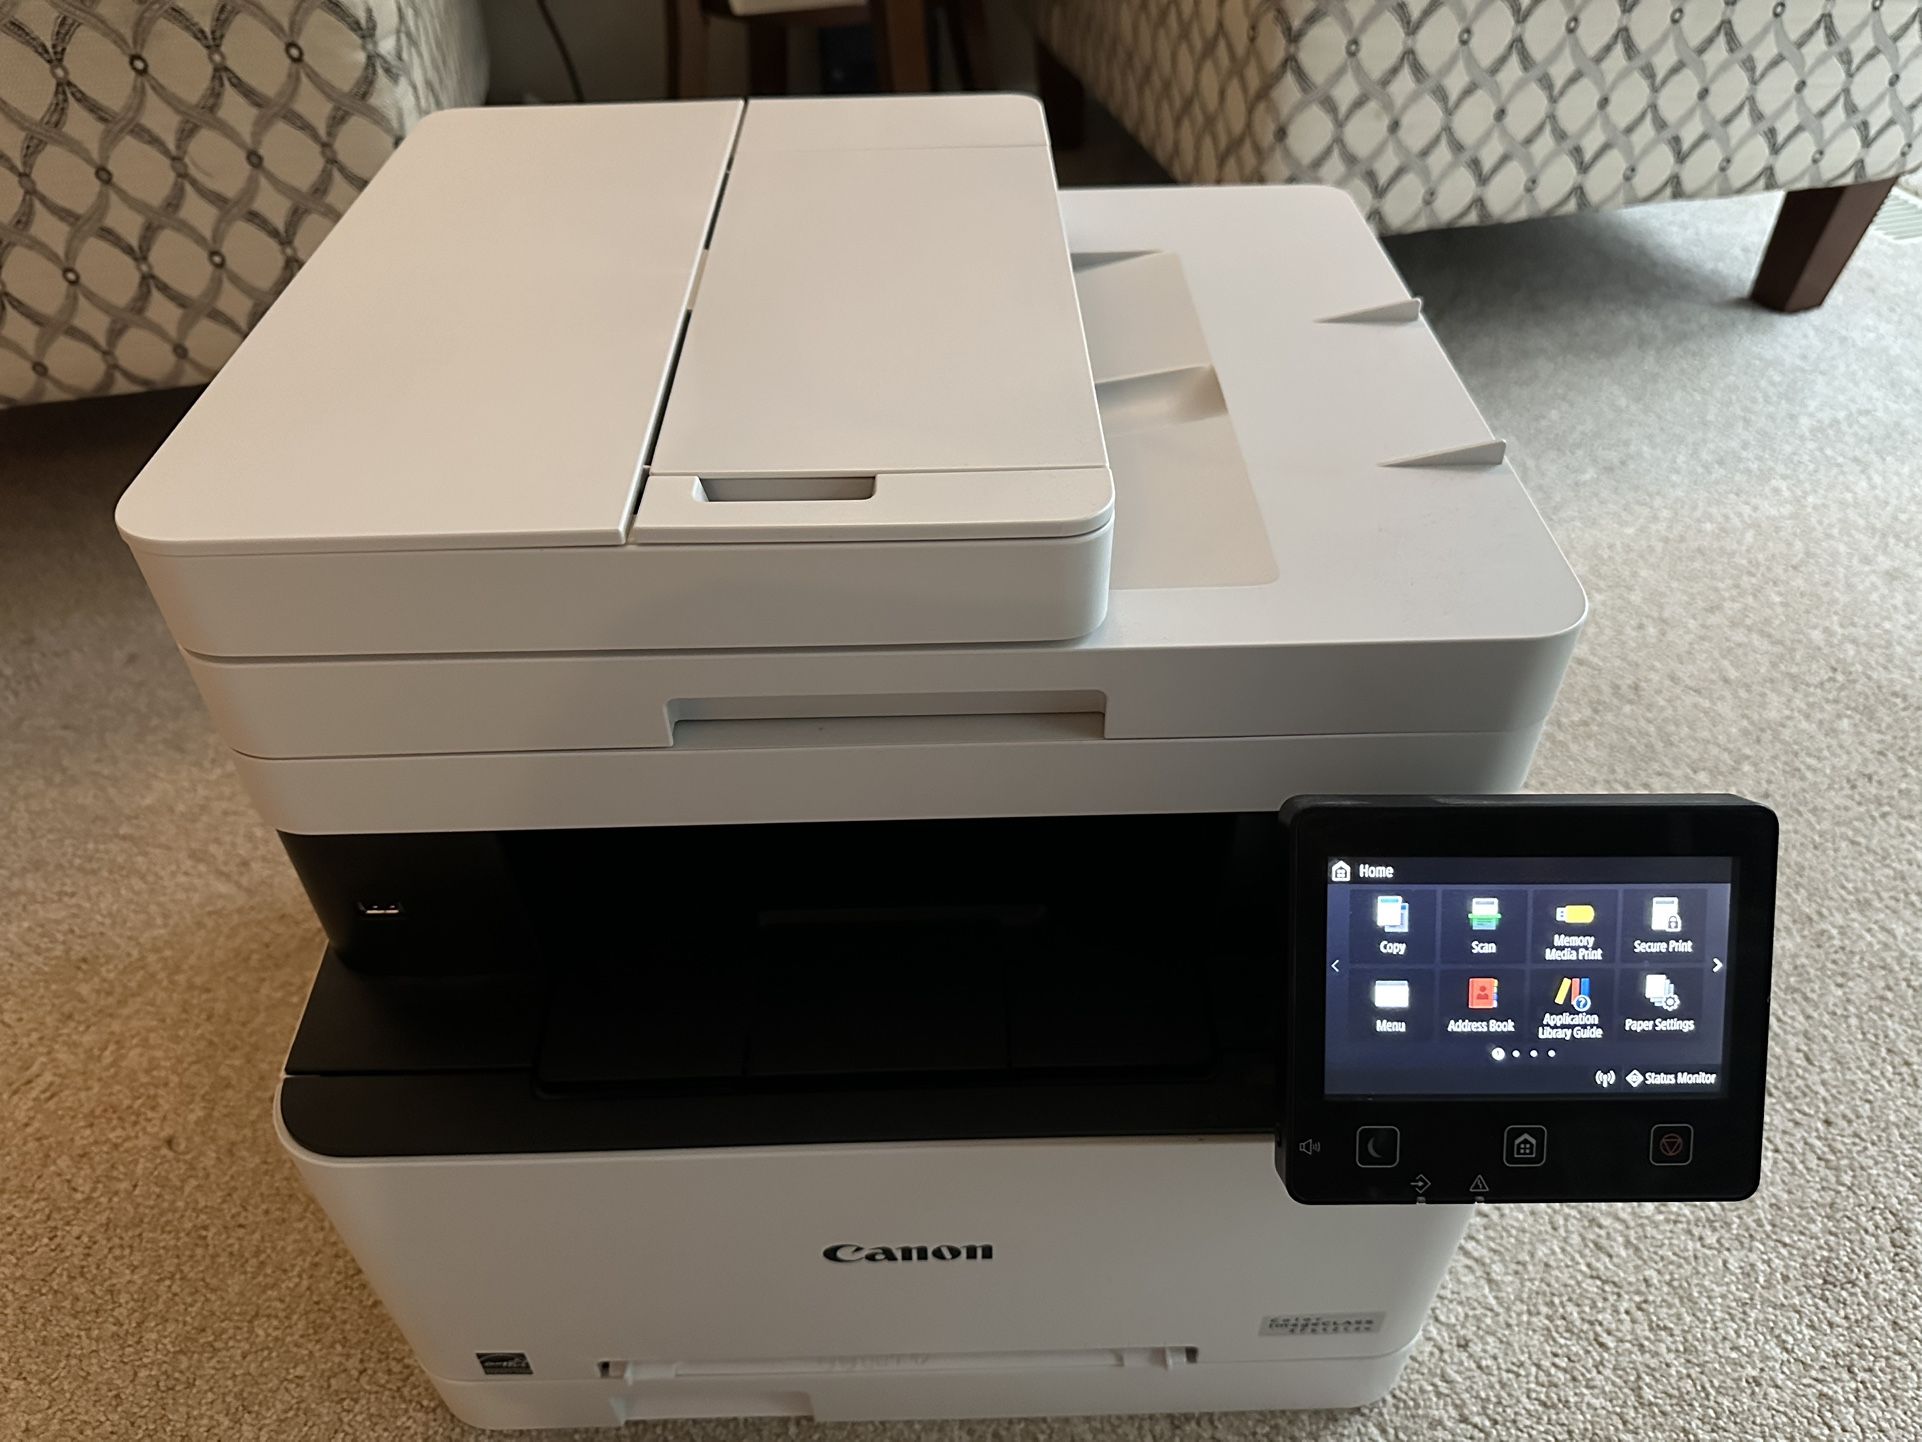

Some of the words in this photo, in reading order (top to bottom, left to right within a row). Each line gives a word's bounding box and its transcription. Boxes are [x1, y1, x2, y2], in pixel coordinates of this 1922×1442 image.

[1359, 863, 1394, 878] Home
[1553, 934, 1595, 947] Memory
[1633, 940, 1668, 953] Secure
[1669, 940, 1693, 952] Print
[1379, 940, 1407, 955] Copy
[1471, 941, 1497, 954] Scan
[1545, 948, 1577, 960] Media
[1578, 948, 1603, 960] Print
[1376, 1019, 1406, 1032] Menu
[1447, 1019, 1488, 1032] Address
[1489, 1019, 1515, 1032] Book
[1543, 1013, 1599, 1026] Application
[1625, 1018, 1653, 1032] Paper
[1654, 1018, 1695, 1032] Settings
[1538, 1027, 1573, 1040] Library
[1573, 1026, 1603, 1039] Guide
[1645, 1072, 1676, 1085] Status
[1677, 1072, 1717, 1085] Monitor
[823, 1243, 993, 1262] Canon
